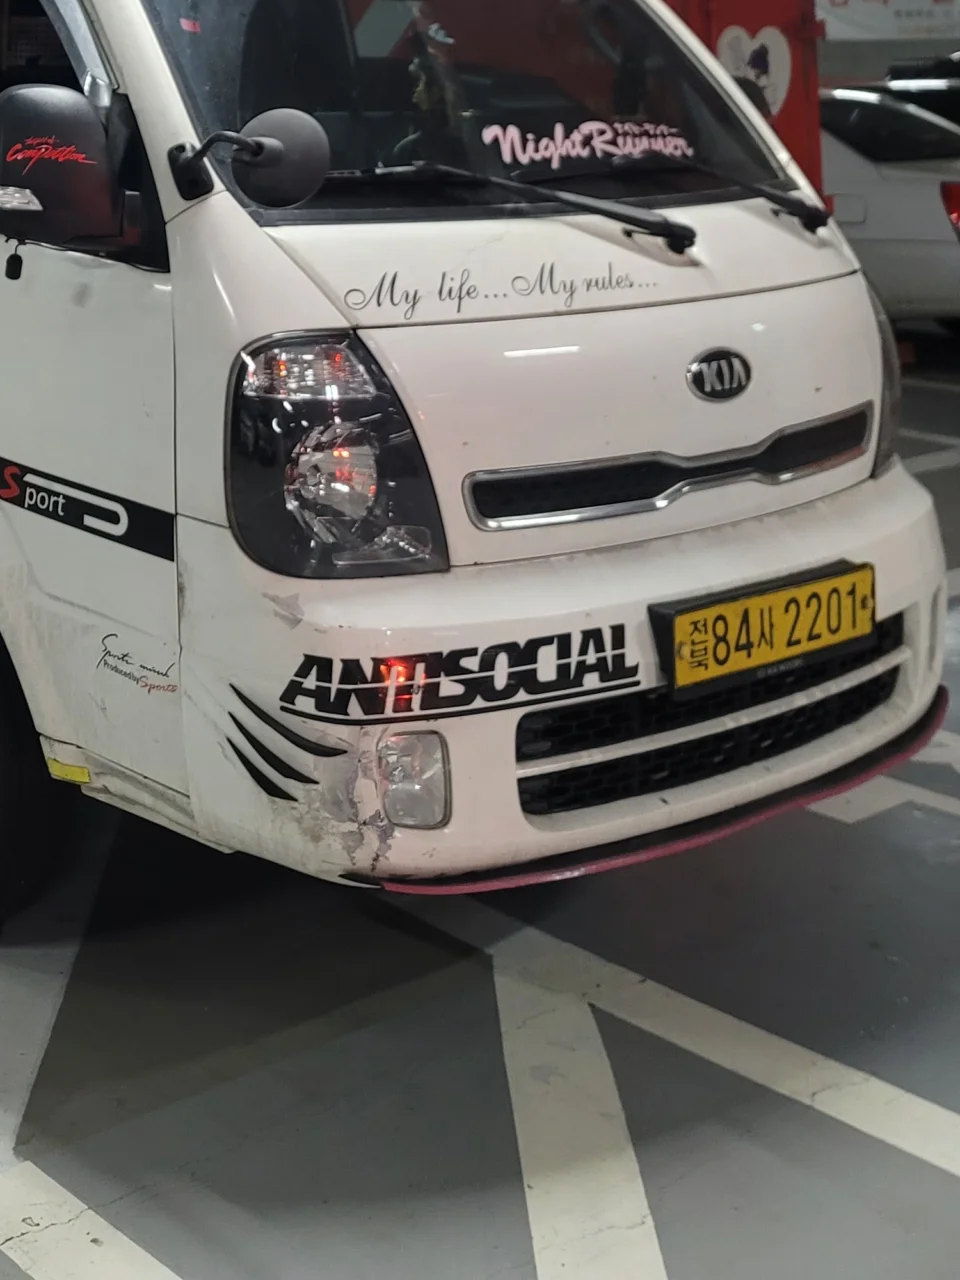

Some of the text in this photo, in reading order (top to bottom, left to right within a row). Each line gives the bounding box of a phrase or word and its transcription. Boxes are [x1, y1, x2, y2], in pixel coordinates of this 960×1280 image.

[344, 271, 421, 320] My
[512, 262, 576, 307] My
[699, 356, 746, 392] KIA
[712, 606, 774, 666] 84사
[784, 582, 857, 648] 2201
[139, 675, 178, 694] Sports
[279, 623, 640, 716] ANTISOCIAL
